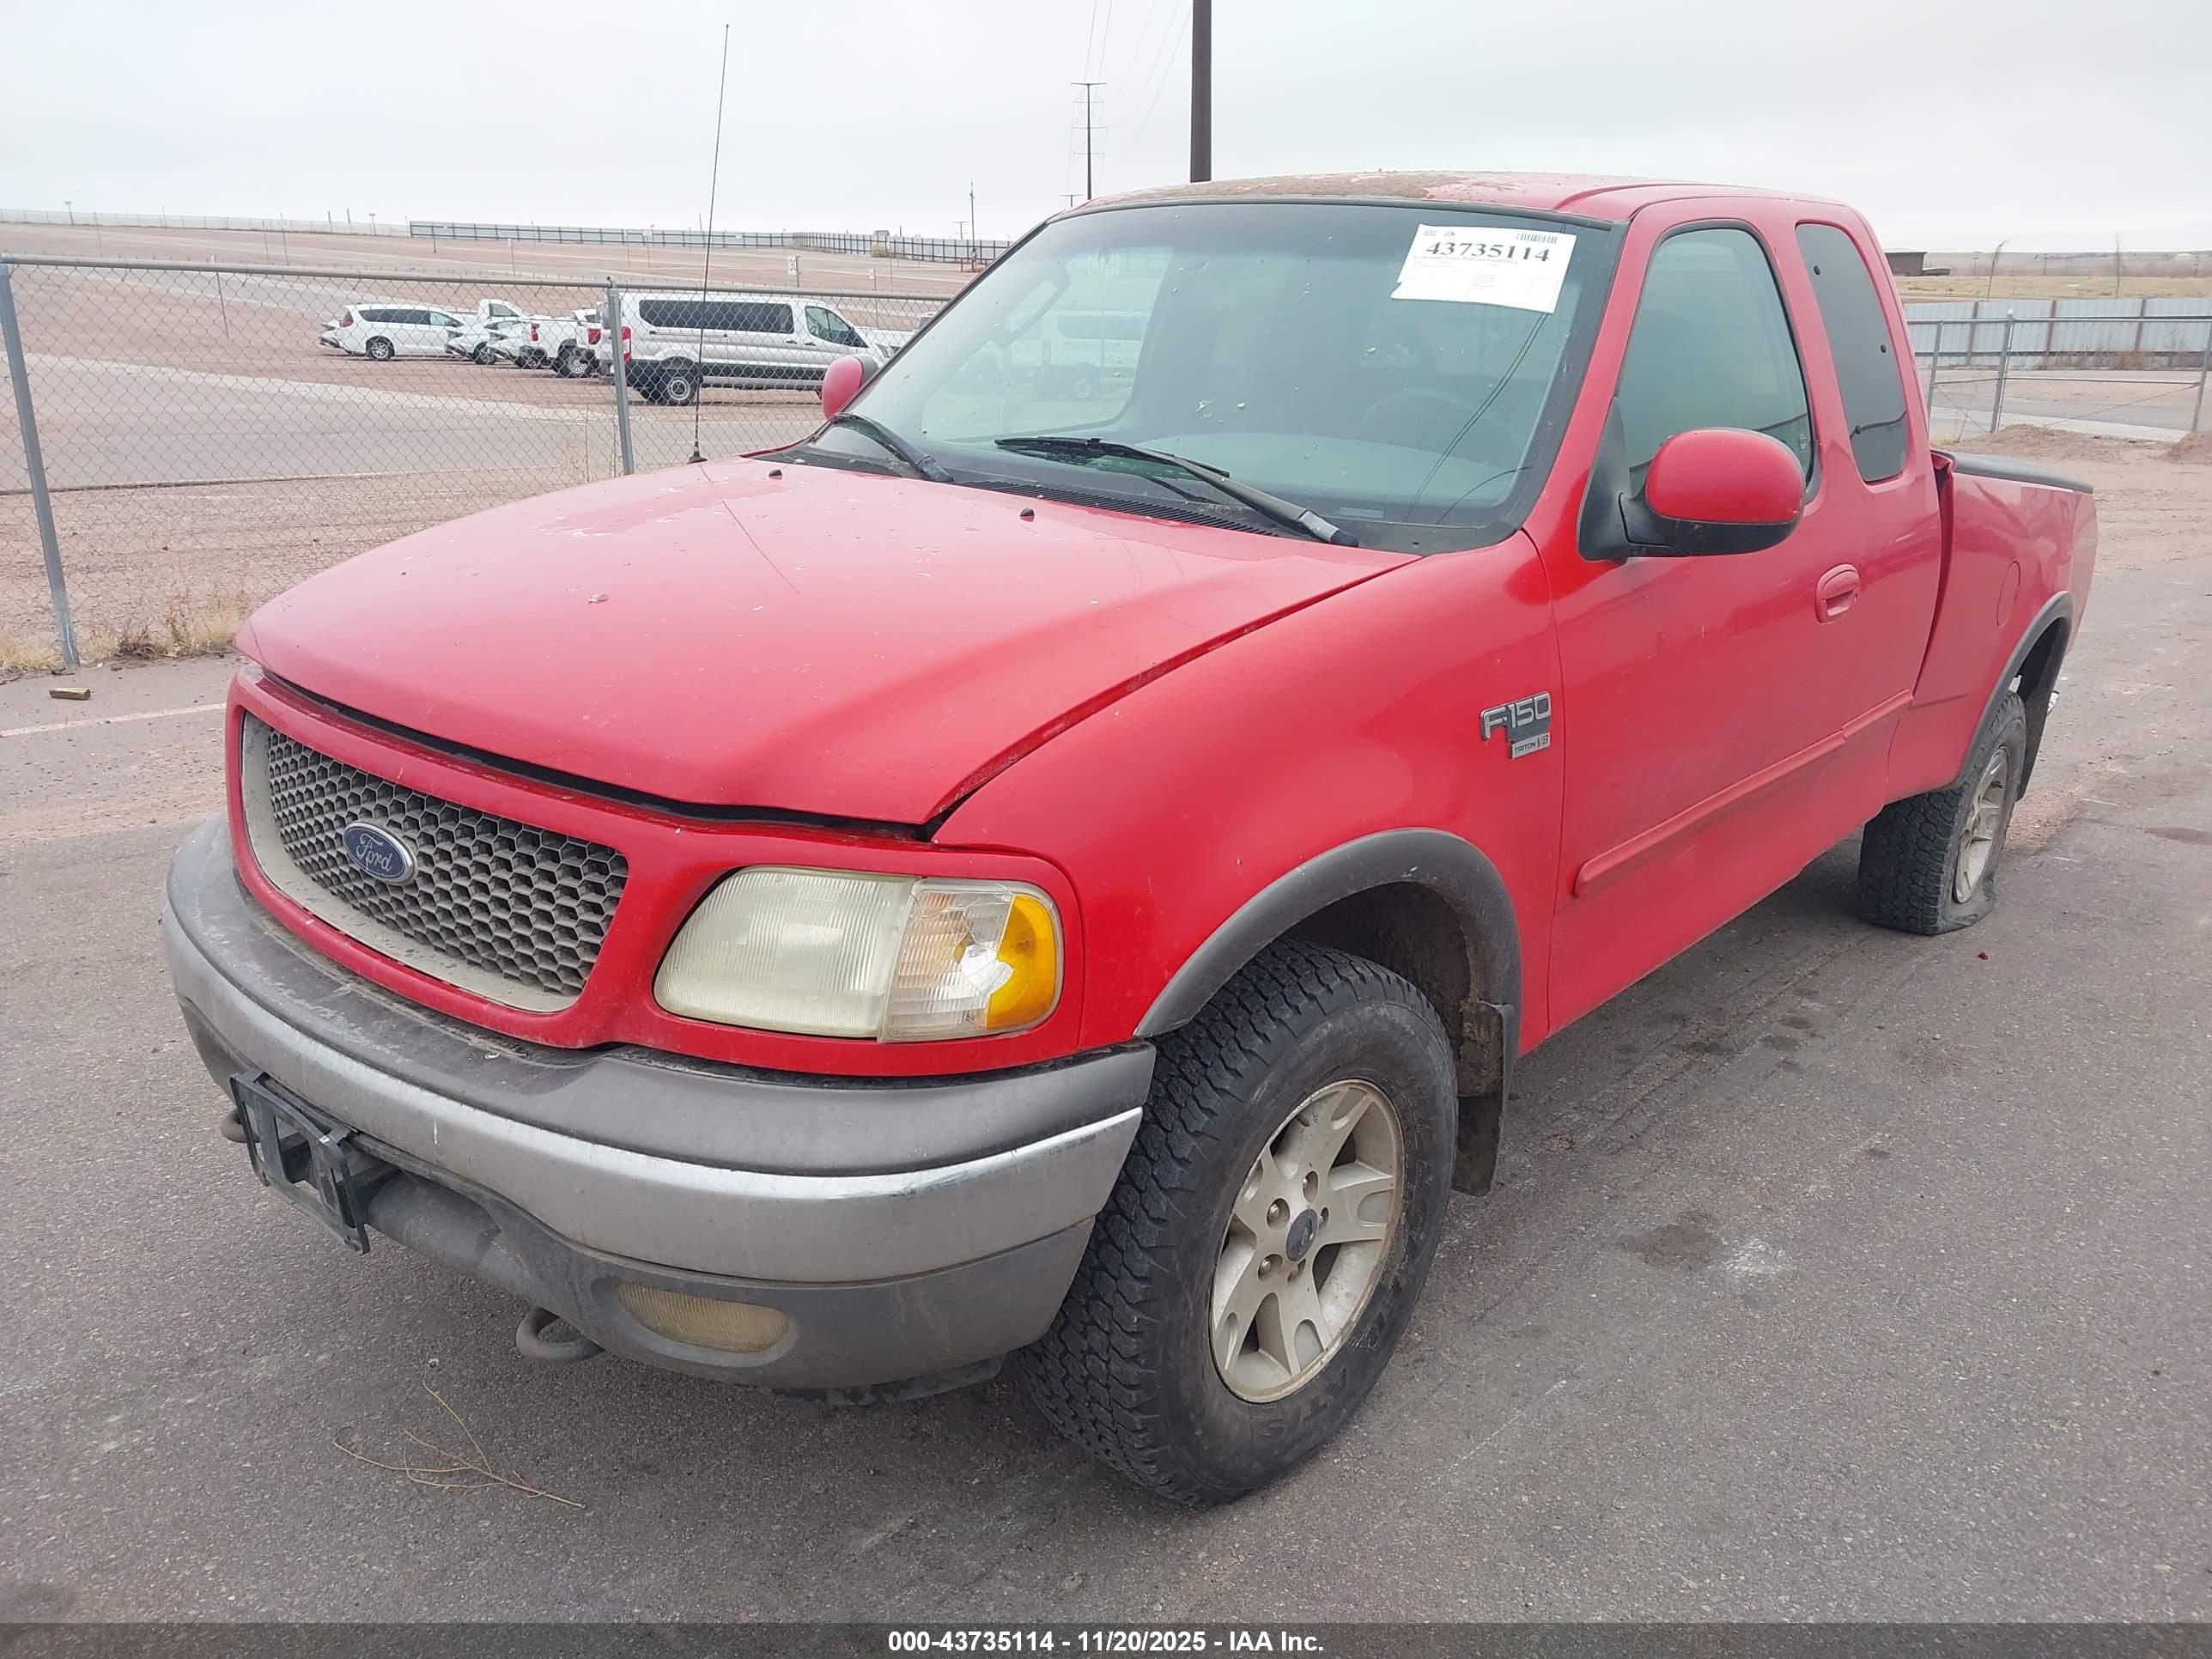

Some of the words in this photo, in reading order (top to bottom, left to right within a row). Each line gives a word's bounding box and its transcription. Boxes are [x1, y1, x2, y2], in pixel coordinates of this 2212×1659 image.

[1425, 241, 1550, 262] 43735114
[1514, 740, 1537, 755] TRITON
[1537, 734, 1549, 749] V8
[356, 833, 393, 872] Ford
